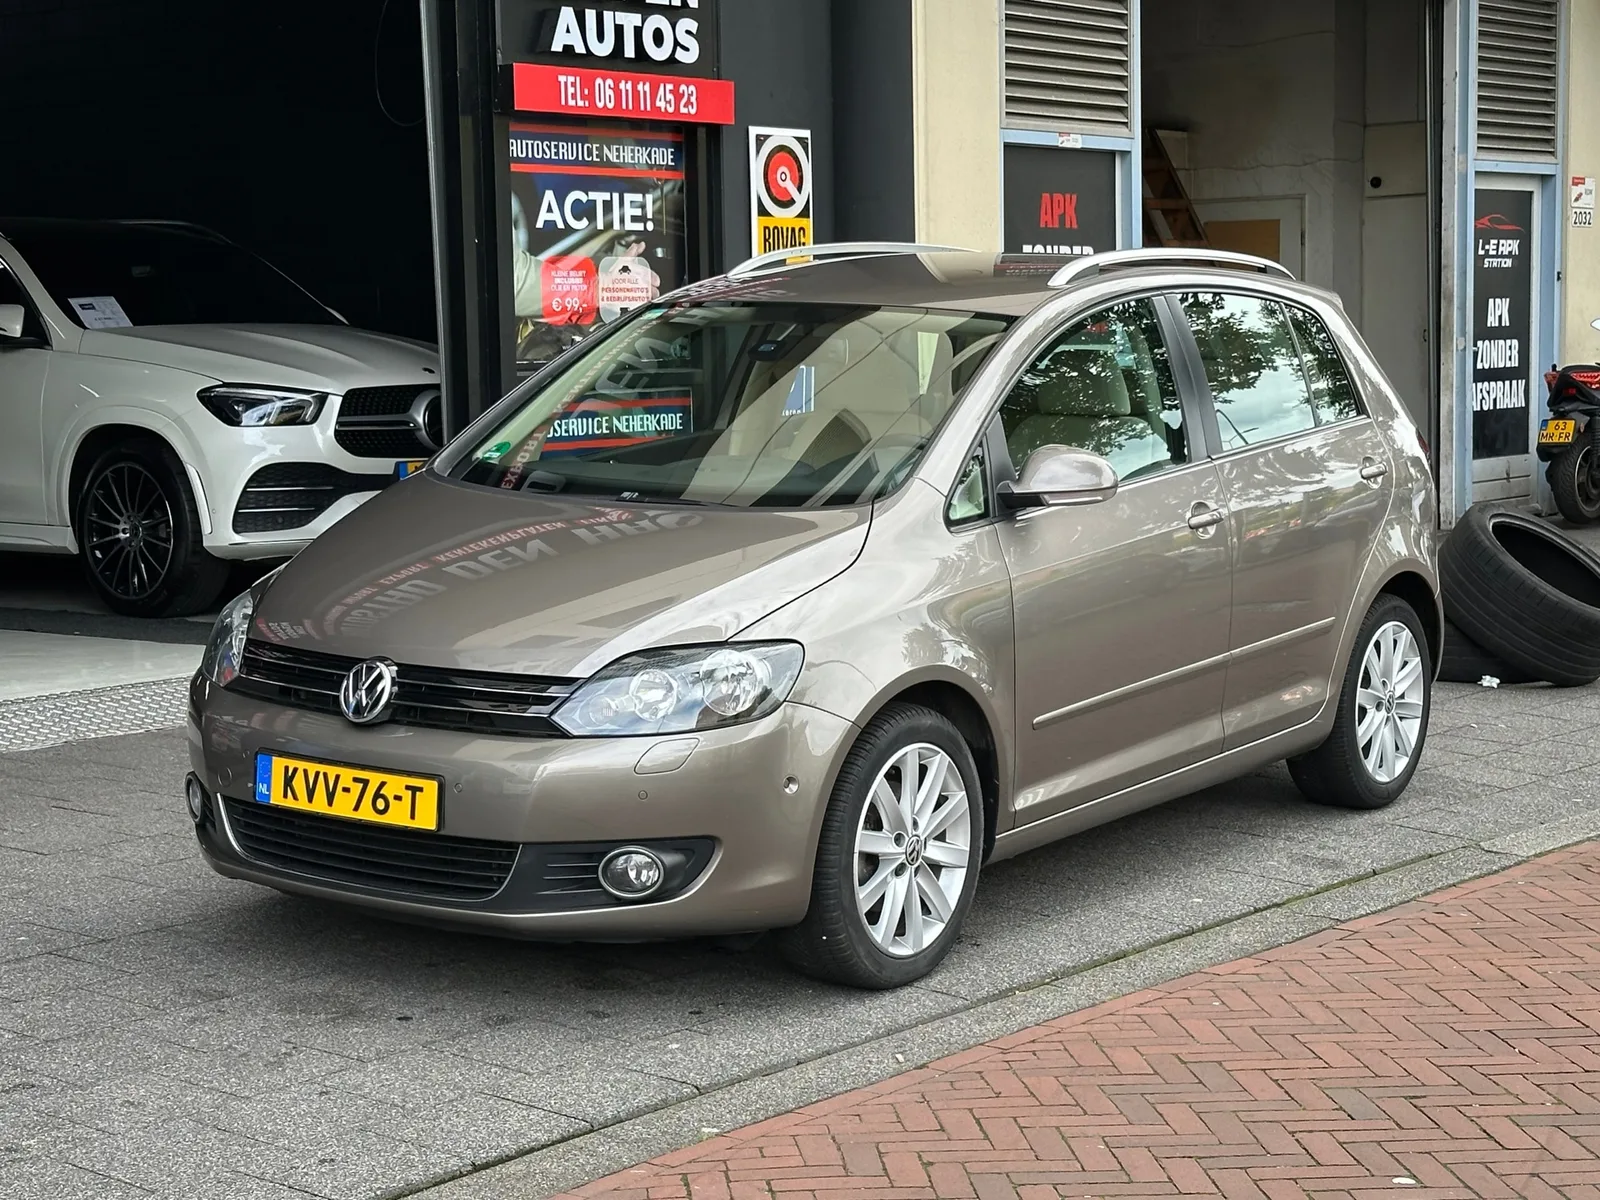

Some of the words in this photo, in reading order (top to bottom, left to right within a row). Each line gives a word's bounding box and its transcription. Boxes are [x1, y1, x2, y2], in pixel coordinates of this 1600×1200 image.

[550, 6, 700, 64] AUTOS
[557, 74, 590, 107] TEL:
[594, 77, 615, 109] 06
[618, 79, 633, 110] 11
[636, 81, 651, 112] 11
[655, 82, 675, 113] 45
[679, 83, 697, 115] 23
[509, 138, 600, 162] AUTOSERVICE
[603, 144, 675, 166] NEHERKADE
[535, 189, 655, 232] ACTIE!
[1039, 192, 1078, 229] APK
[1573, 211, 1592, 225] 2032
[763, 225, 806, 254] BOVAG
[1478, 238, 1498, 255] L-E
[1498, 239, 1520, 255] APK
[1483, 258, 1512, 268] STATION
[1486, 297, 1511, 328] APK
[1476, 338, 1519, 370] ZONDER
[1472, 379, 1526, 412] AFSPRAAK
[612, 412, 684, 434] NEHERKADE
[1554, 421, 1568, 431] 63
[258, 782, 270, 796] NL
[282, 764, 425, 821] KVV-76-T
